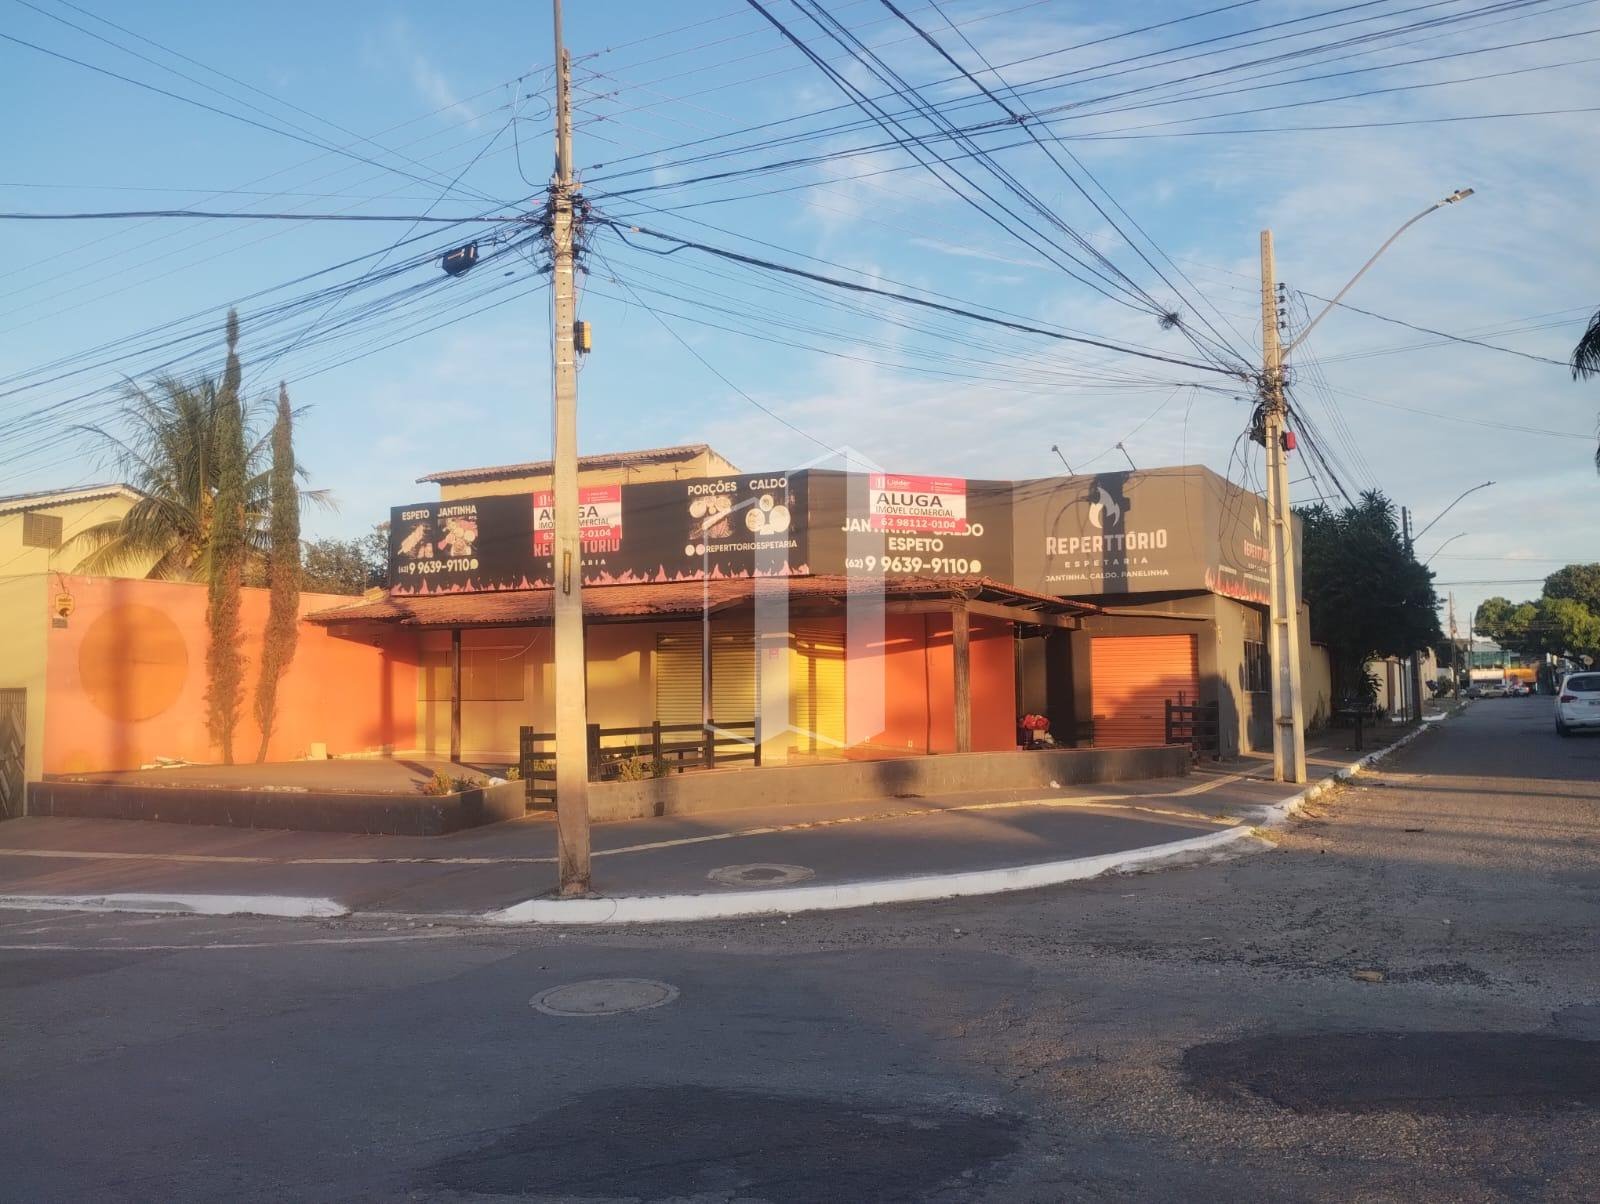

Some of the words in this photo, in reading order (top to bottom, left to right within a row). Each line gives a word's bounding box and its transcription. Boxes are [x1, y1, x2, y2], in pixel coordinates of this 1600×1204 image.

[688, 480, 737, 496] PORÇÕES
[749, 477, 788, 490] CALDO
[876, 492, 943, 508] ALUGA
[401, 509, 430, 521] ESPETO
[437, 504, 478, 517] JANTINHA
[539, 505, 598, 521] AGA
[908, 507, 954, 517] COMERCIAL
[538, 521, 556, 529] IMO
[578, 518, 609, 527] MERCIAL
[880, 517, 894, 526] 62
[896, 518, 956, 529] 98112-0104
[579, 529, 611, 539] 2-0104
[534, 539, 620, 558] RETRIO
[705, 539, 798, 553] REPERTTORIOESPETARIA
[888, 537, 944, 553] ESPETO
[1046, 528, 1168, 556] REPERTTÓRIO
[409, 562, 416, 575] 9
[417, 557, 470, 575] 9639-9110
[546, 559, 607, 569] EARIA
[845, 558, 863, 569] (62)
[864, 555, 877, 572] 9
[880, 556, 968, 574] 9639-9110
[1064, 556, 1148, 569] ESPETARIA
[1121, 569, 1169, 578] PANELINHA
